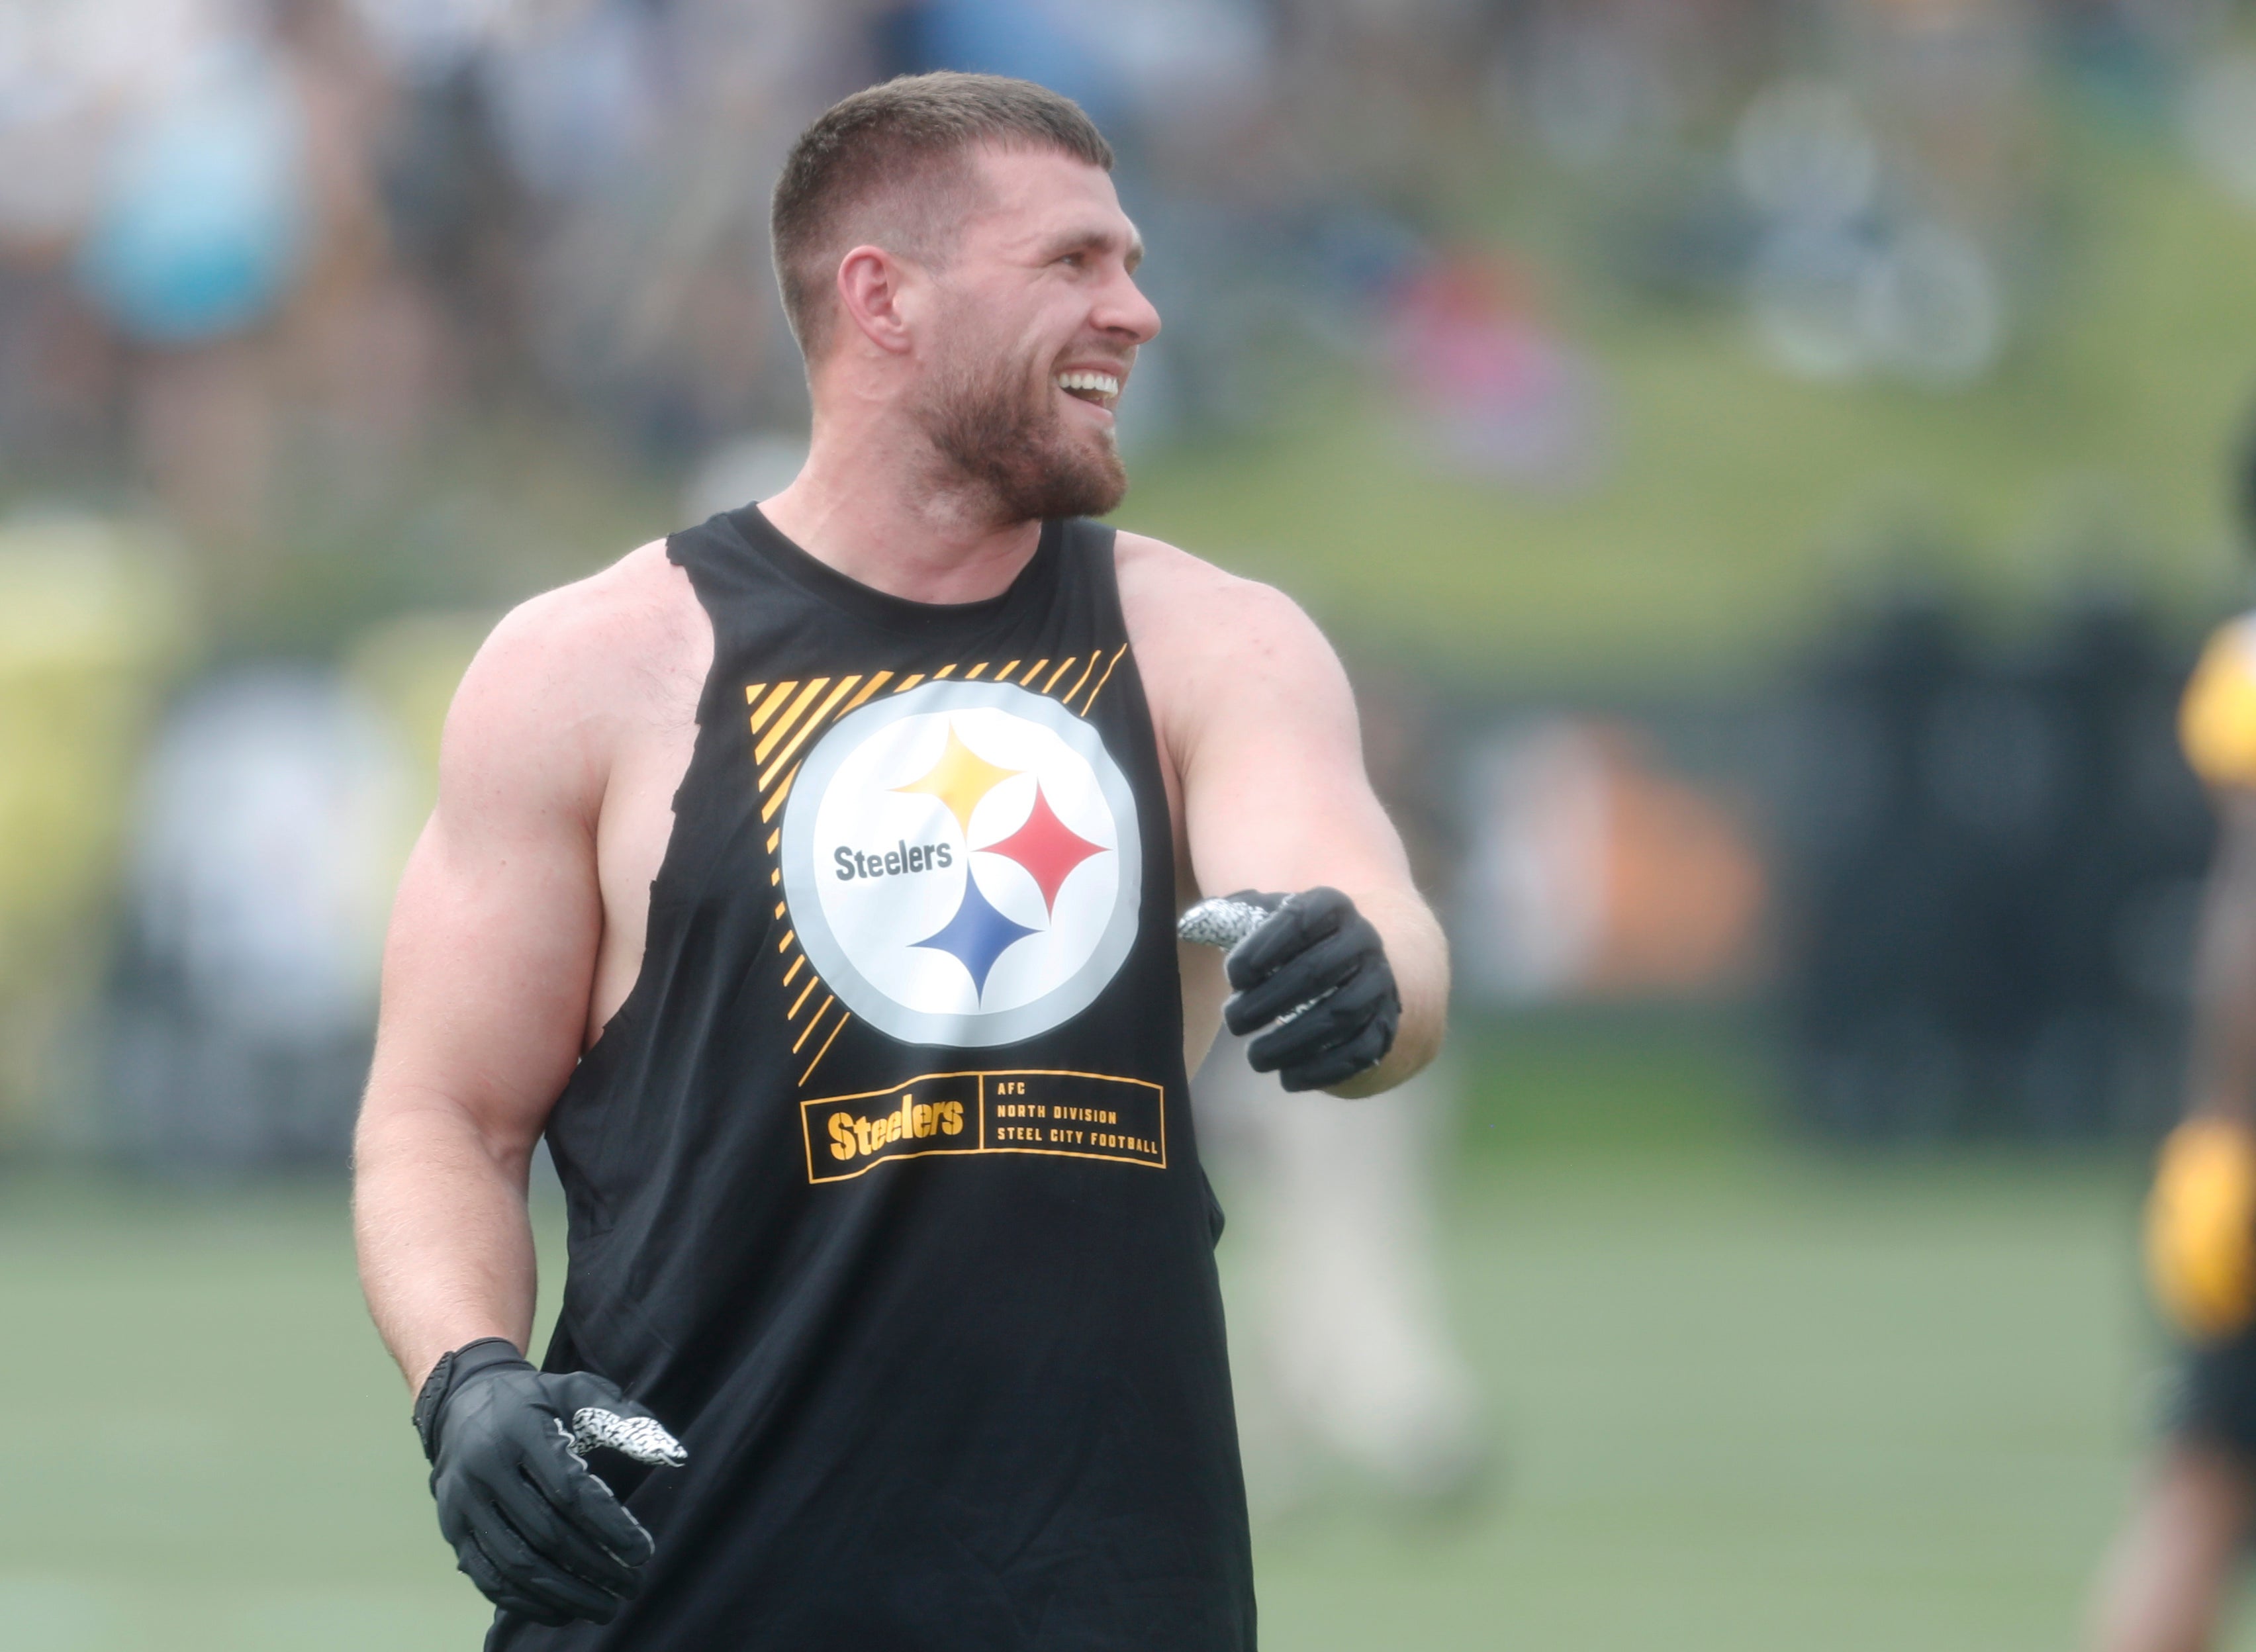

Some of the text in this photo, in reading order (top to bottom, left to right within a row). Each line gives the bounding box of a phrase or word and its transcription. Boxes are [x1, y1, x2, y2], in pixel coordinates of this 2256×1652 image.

[833, 839, 953, 881] Steelers
[998, 1081, 1025, 1095] AFC
[828, 1093, 964, 1161] Steelers
[997, 1105, 1117, 1124] NORTH DIVISION
[997, 1127, 1158, 1154] STEEL CITY FOOTBALL
